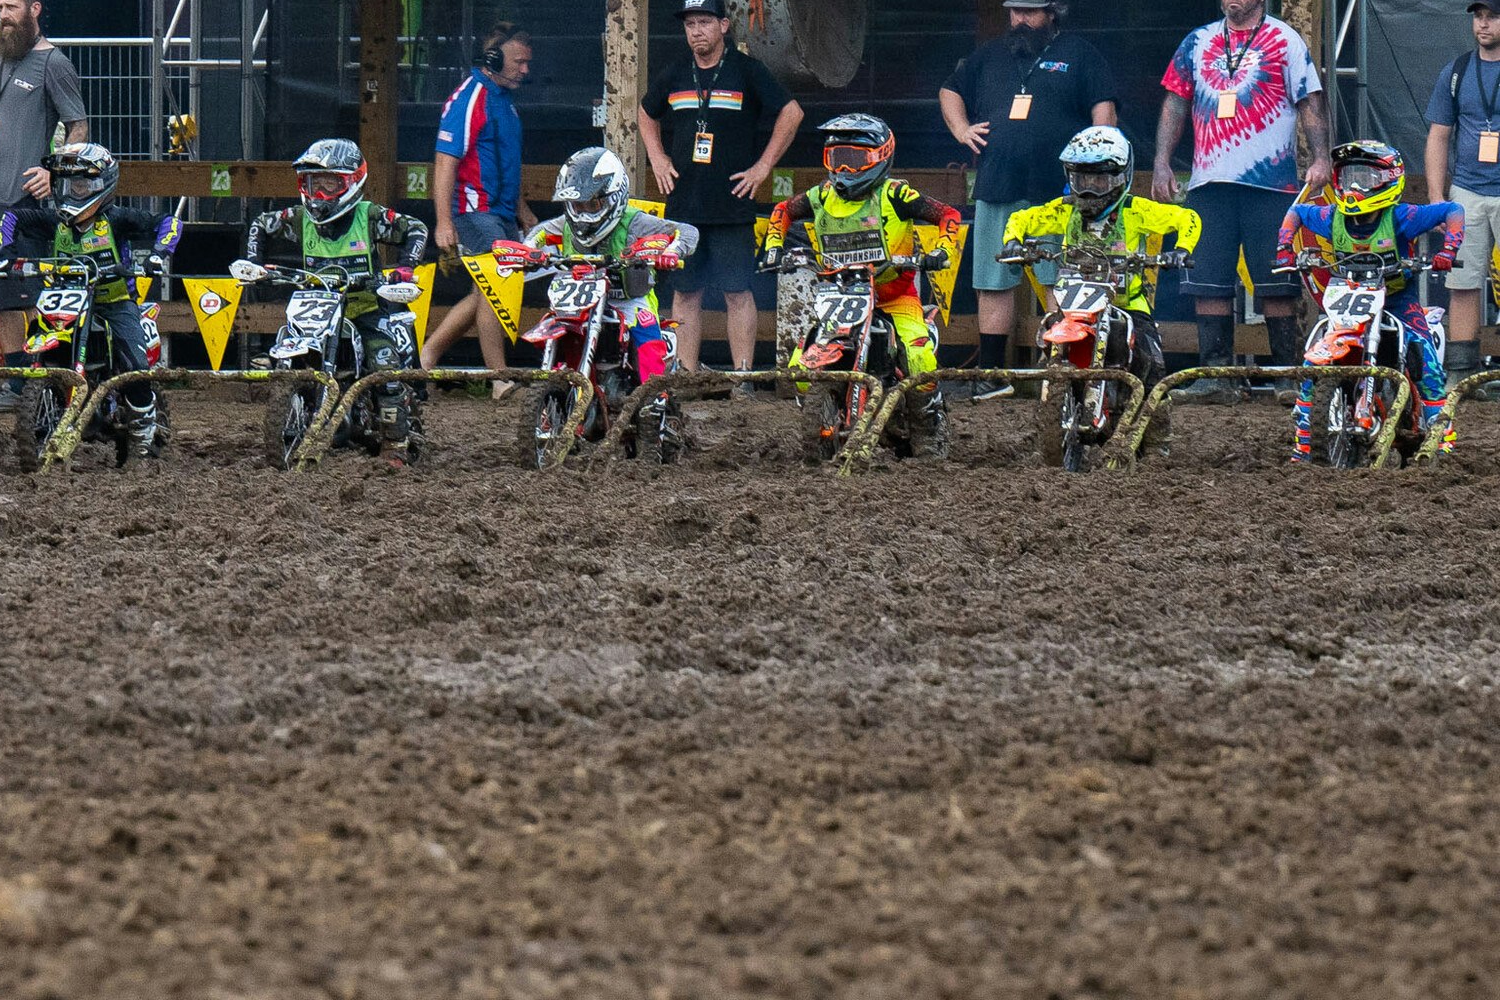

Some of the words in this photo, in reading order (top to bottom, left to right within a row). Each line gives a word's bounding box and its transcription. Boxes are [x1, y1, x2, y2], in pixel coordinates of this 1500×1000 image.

[212, 169, 232, 190] 23
[44, 293, 82, 312] 32
[467, 260, 517, 334] DUNLOP
[555, 281, 597, 308] 28
[1328, 293, 1378, 316] 46
[293, 299, 335, 322] 23
[821, 297, 868, 325] 78
